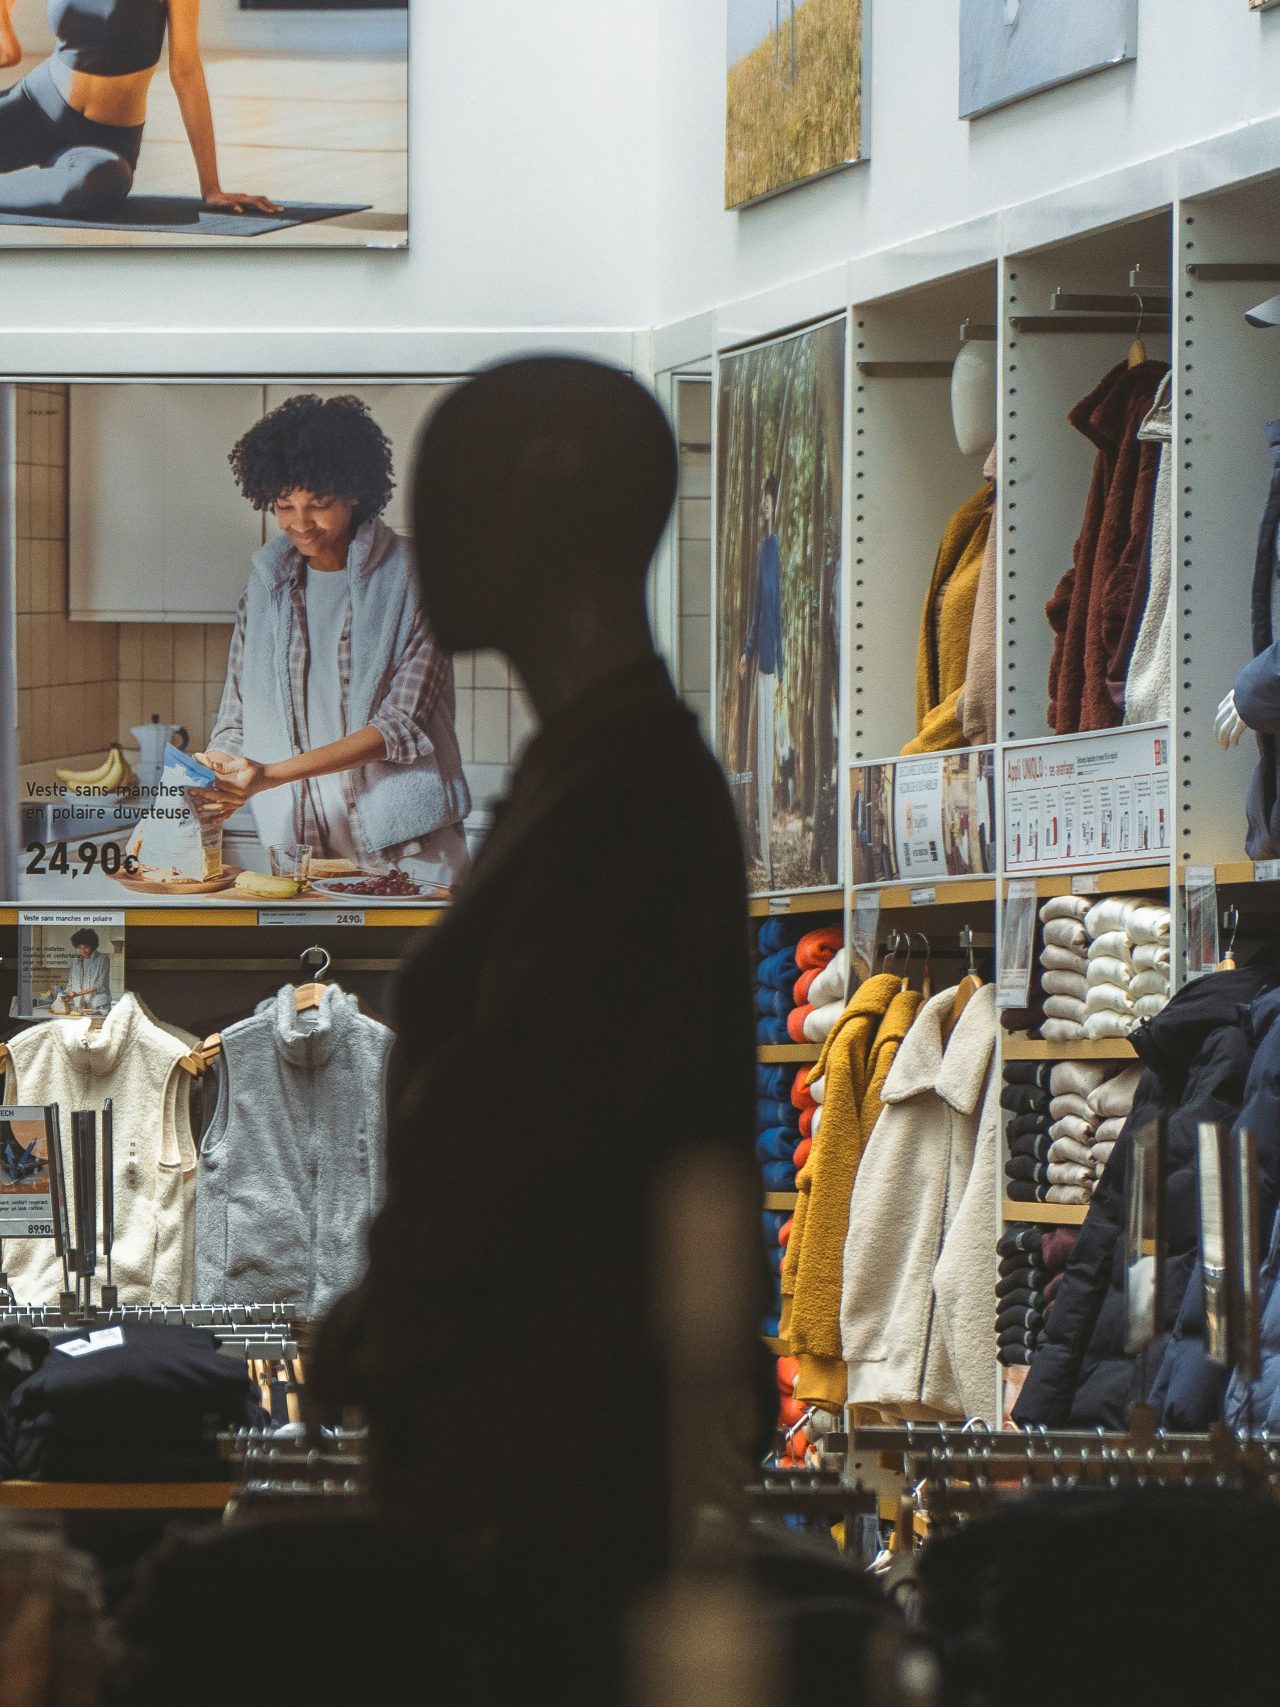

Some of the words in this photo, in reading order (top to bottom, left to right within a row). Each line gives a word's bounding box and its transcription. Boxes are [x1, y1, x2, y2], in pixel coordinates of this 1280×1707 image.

[1022, 755, 1044, 782] UNIQLO
[26, 782, 68, 797] Veste
[75, 785, 109, 797] sans
[116, 782, 185, 797] manches
[26, 807, 44, 820] en
[53, 804, 106, 823] polaire
[113, 804, 191, 820] duveteuse
[25, 841, 139, 879] 24,90€
[23, 914, 39, 922] Veste
[56, 914, 81, 922] manches
[92, 914, 112, 923] polaire
